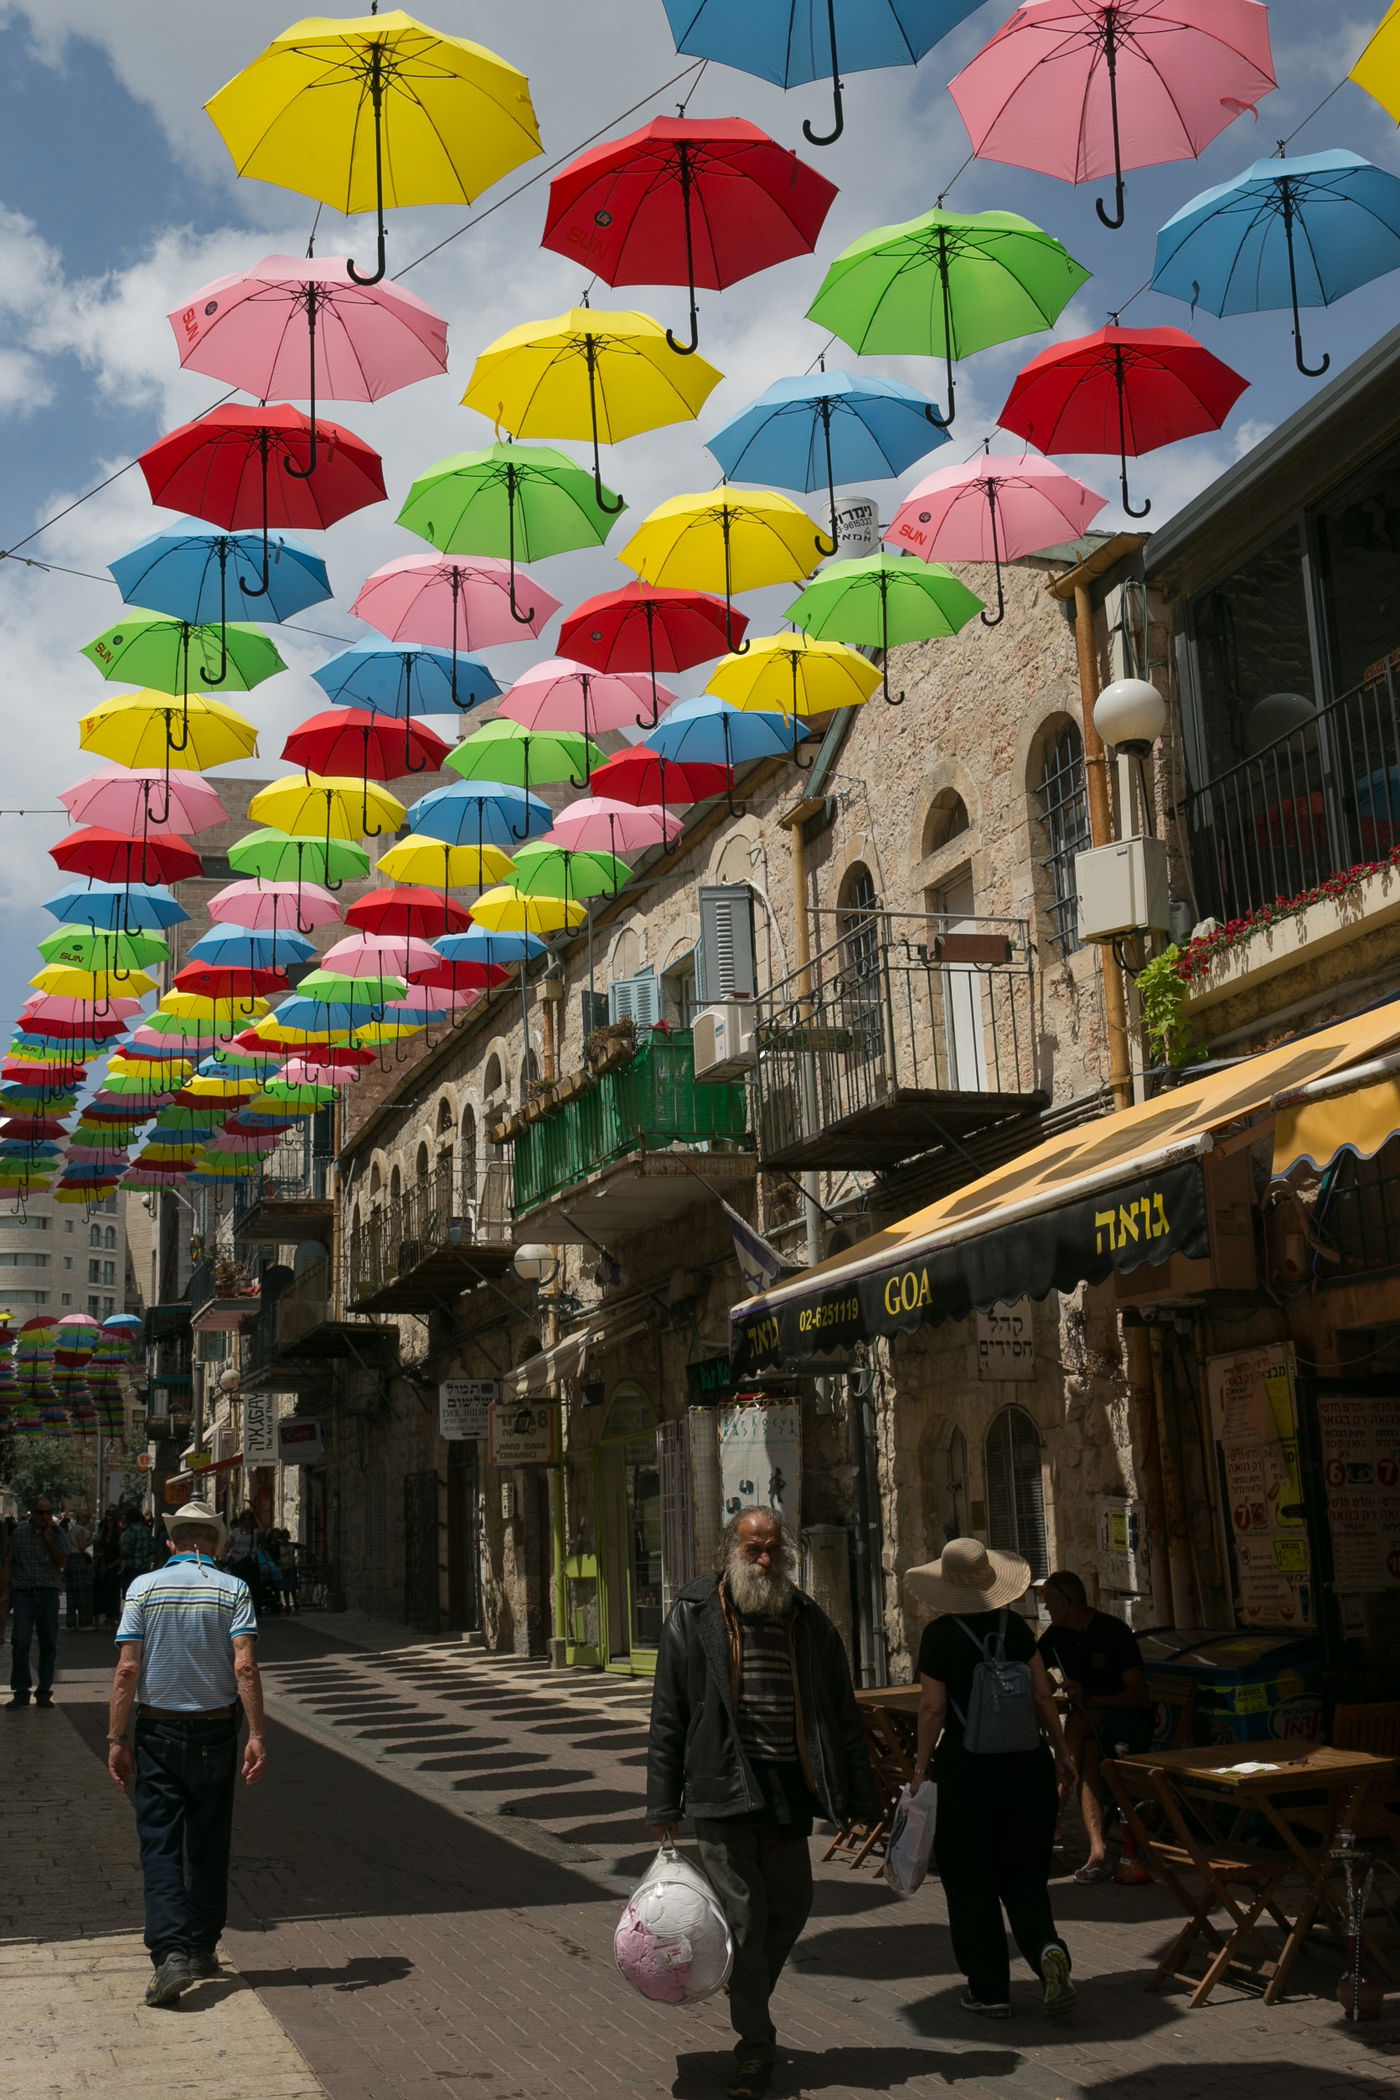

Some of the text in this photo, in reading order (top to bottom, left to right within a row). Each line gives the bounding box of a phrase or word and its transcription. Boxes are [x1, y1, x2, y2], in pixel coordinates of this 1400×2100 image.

[566, 225, 611, 258] SUN
[182, 307, 199, 342] SUN
[837, 505, 873, 525] נימרו
[899, 523, 928, 546] SUN
[95, 641, 114, 664] SUN
[59, 951, 85, 964] SUN
[1095, 1192, 1171, 1255] גואה
[884, 1266, 934, 1316] GOA
[799, 1297, 860, 1333] 02-6251119
[987, 1308, 1024, 1337] קהל
[747, 1315, 780, 1359] גואה
[979, 1340, 1033, 1358] חסידים
[446, 1383, 481, 1394] תמול
[447, 1395, 494, 1408] שלשום
[1353, 1415, 1367, 1426] רק
[1237, 1507, 1247, 1526] 7
